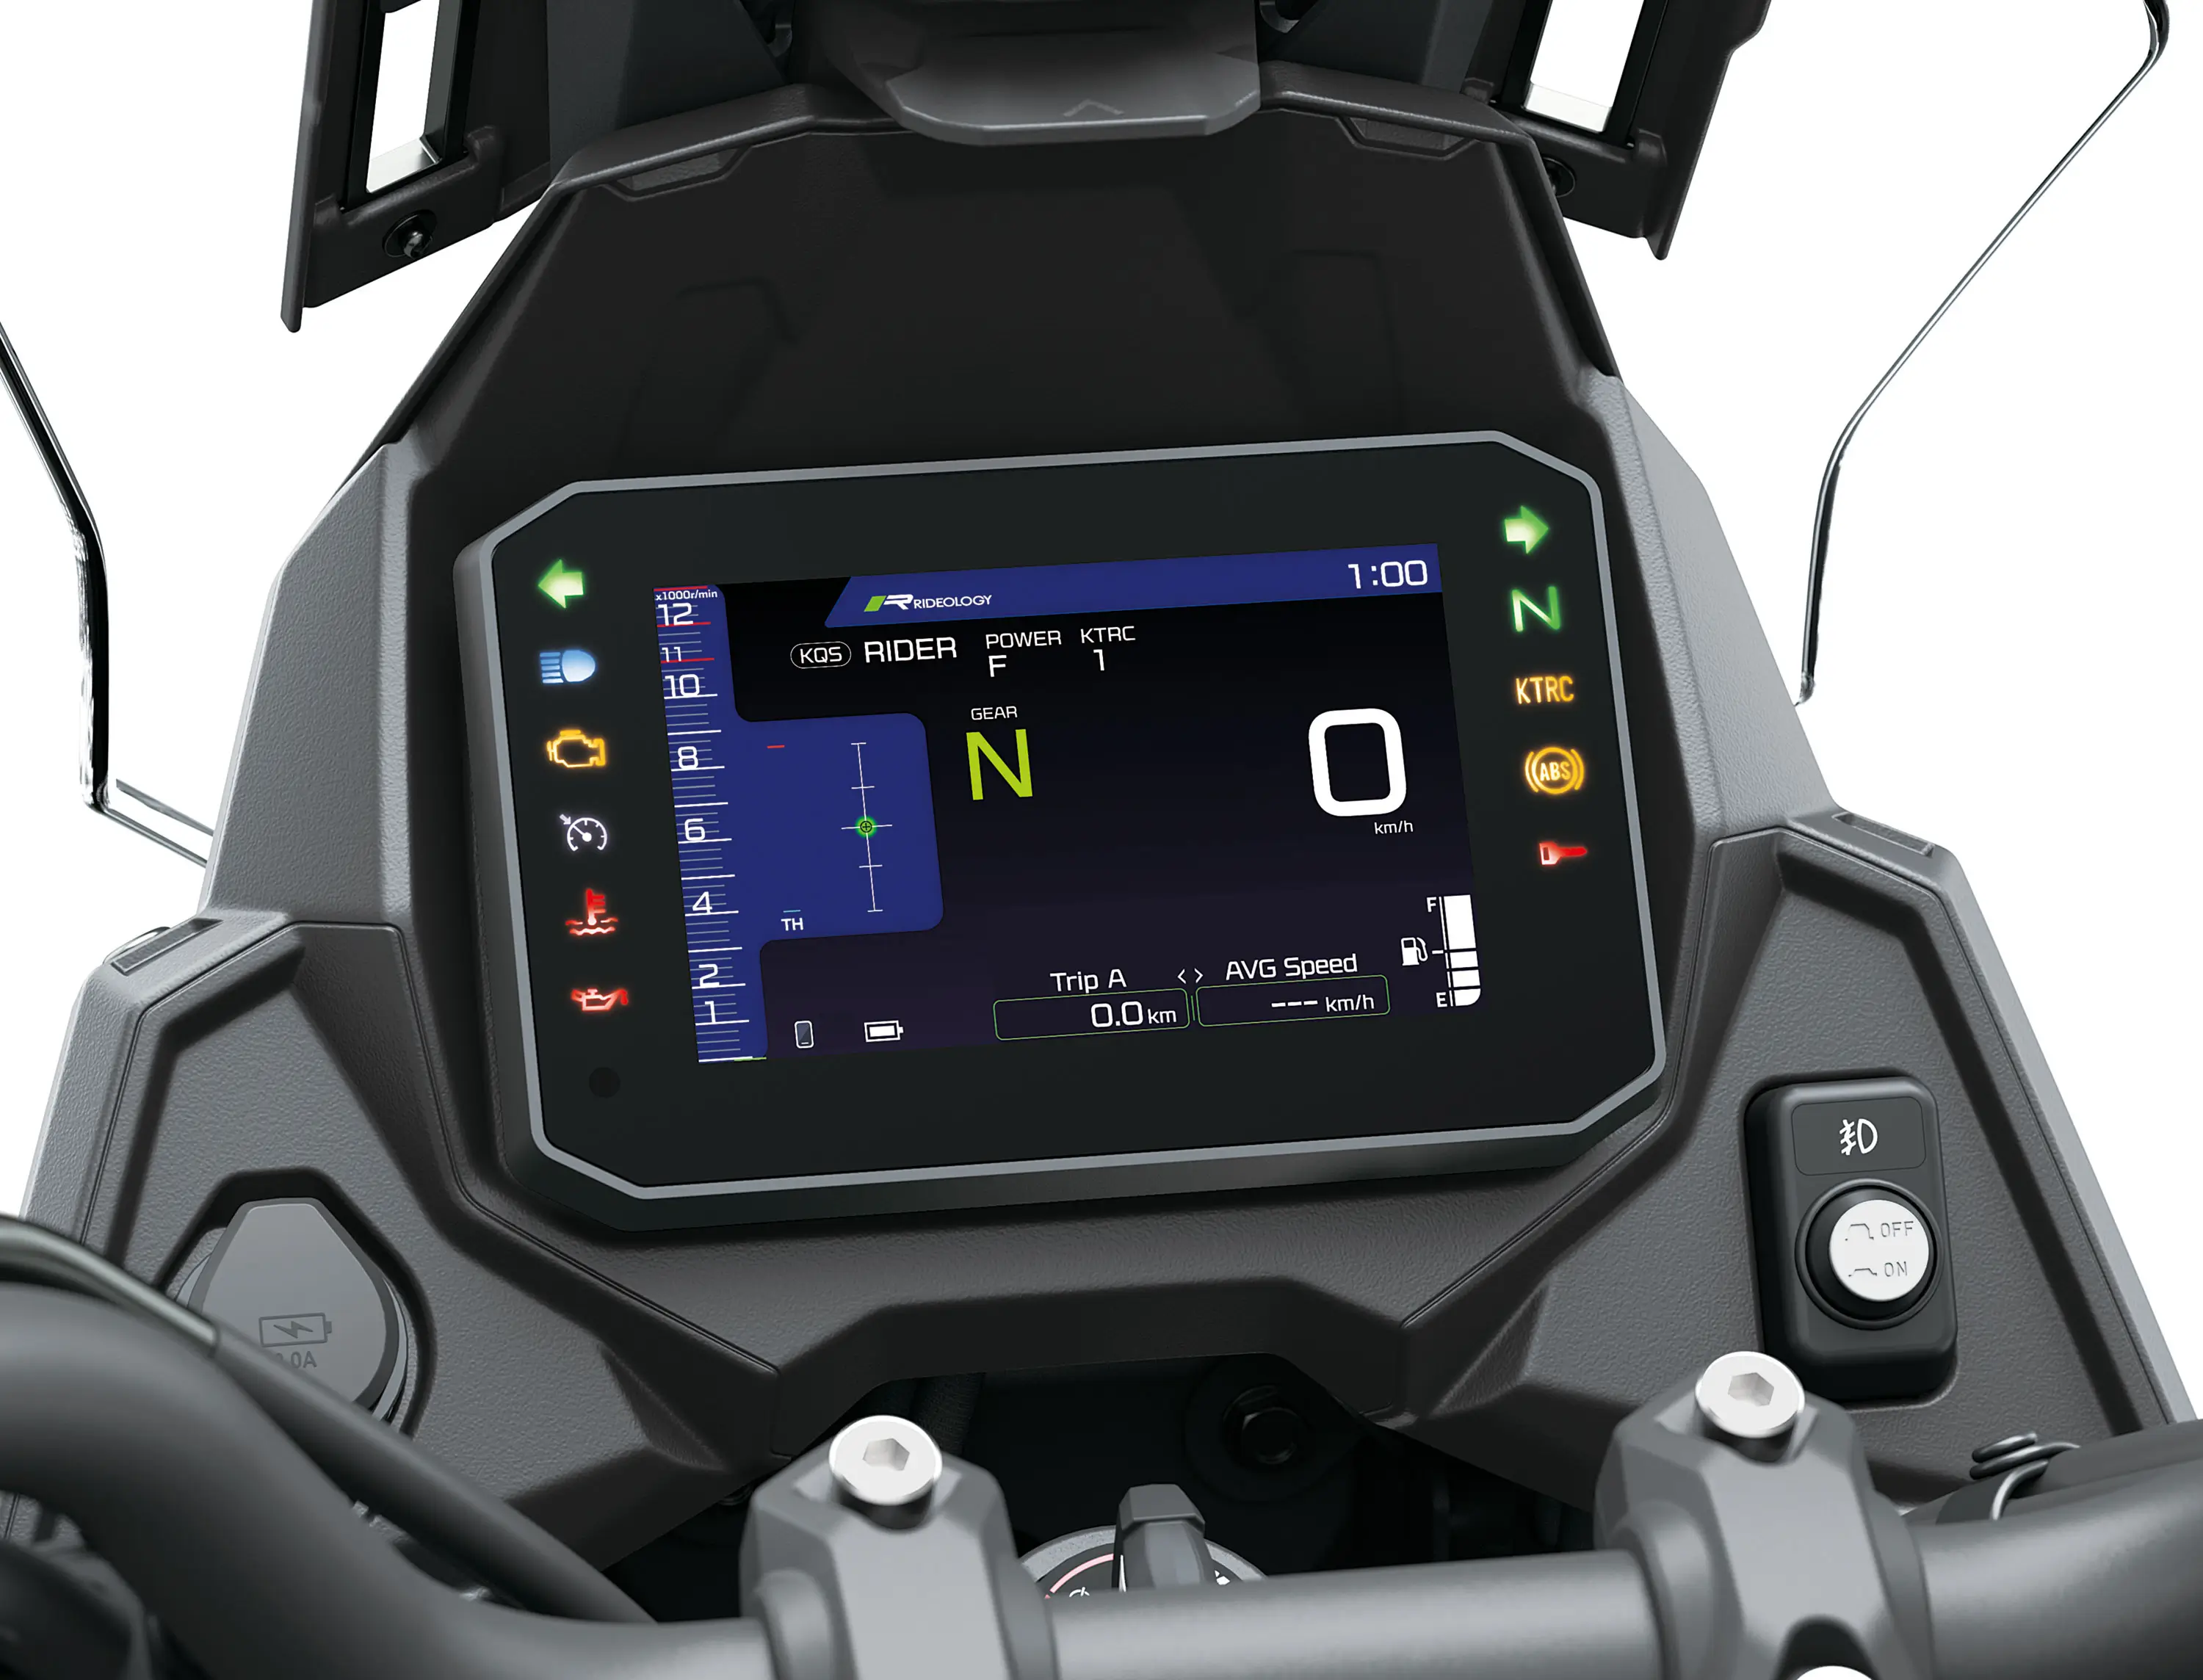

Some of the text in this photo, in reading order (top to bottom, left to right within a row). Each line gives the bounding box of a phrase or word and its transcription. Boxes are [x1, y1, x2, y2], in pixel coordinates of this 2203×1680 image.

[1348, 560, 1428, 588] 1:00
[914, 595, 992, 609] RIDEOLOGY
[1511, 586, 1560, 632] N
[658, 603, 693, 626] 12
[986, 626, 1136, 648] POWER KTRC
[662, 646, 682, 662] 11
[800, 637, 957, 663] KQS RIDER
[989, 649, 1105, 677] F 1
[665, 674, 700, 697] 10
[1516, 675, 1574, 704] KTRC
[971, 706, 1018, 720] GEAR
[678, 746, 698, 769] 8
[966, 729, 1032, 800] N
[1309, 708, 1406, 817] 0
[1539, 761, 1571, 782] ABS
[684, 818, 706, 841] 6
[1374, 820, 1414, 835] km/h
[692, 891, 712, 913] 4
[1427, 897, 1437, 913] F
[781, 917, 804, 931] TH
[698, 963, 720, 988] 2
[1226, 953, 1358, 980] AVG Speed
[1050, 969, 1127, 993] Trip A
[1325, 994, 1375, 1012] km/h
[1436, 992, 1447, 1008] E
[704, 1001, 716, 1023] 1
[1090, 1001, 1177, 1027] 0.0 km
[1881, 1220, 1914, 1238] OFF
[1884, 1261, 1908, 1278] ON
